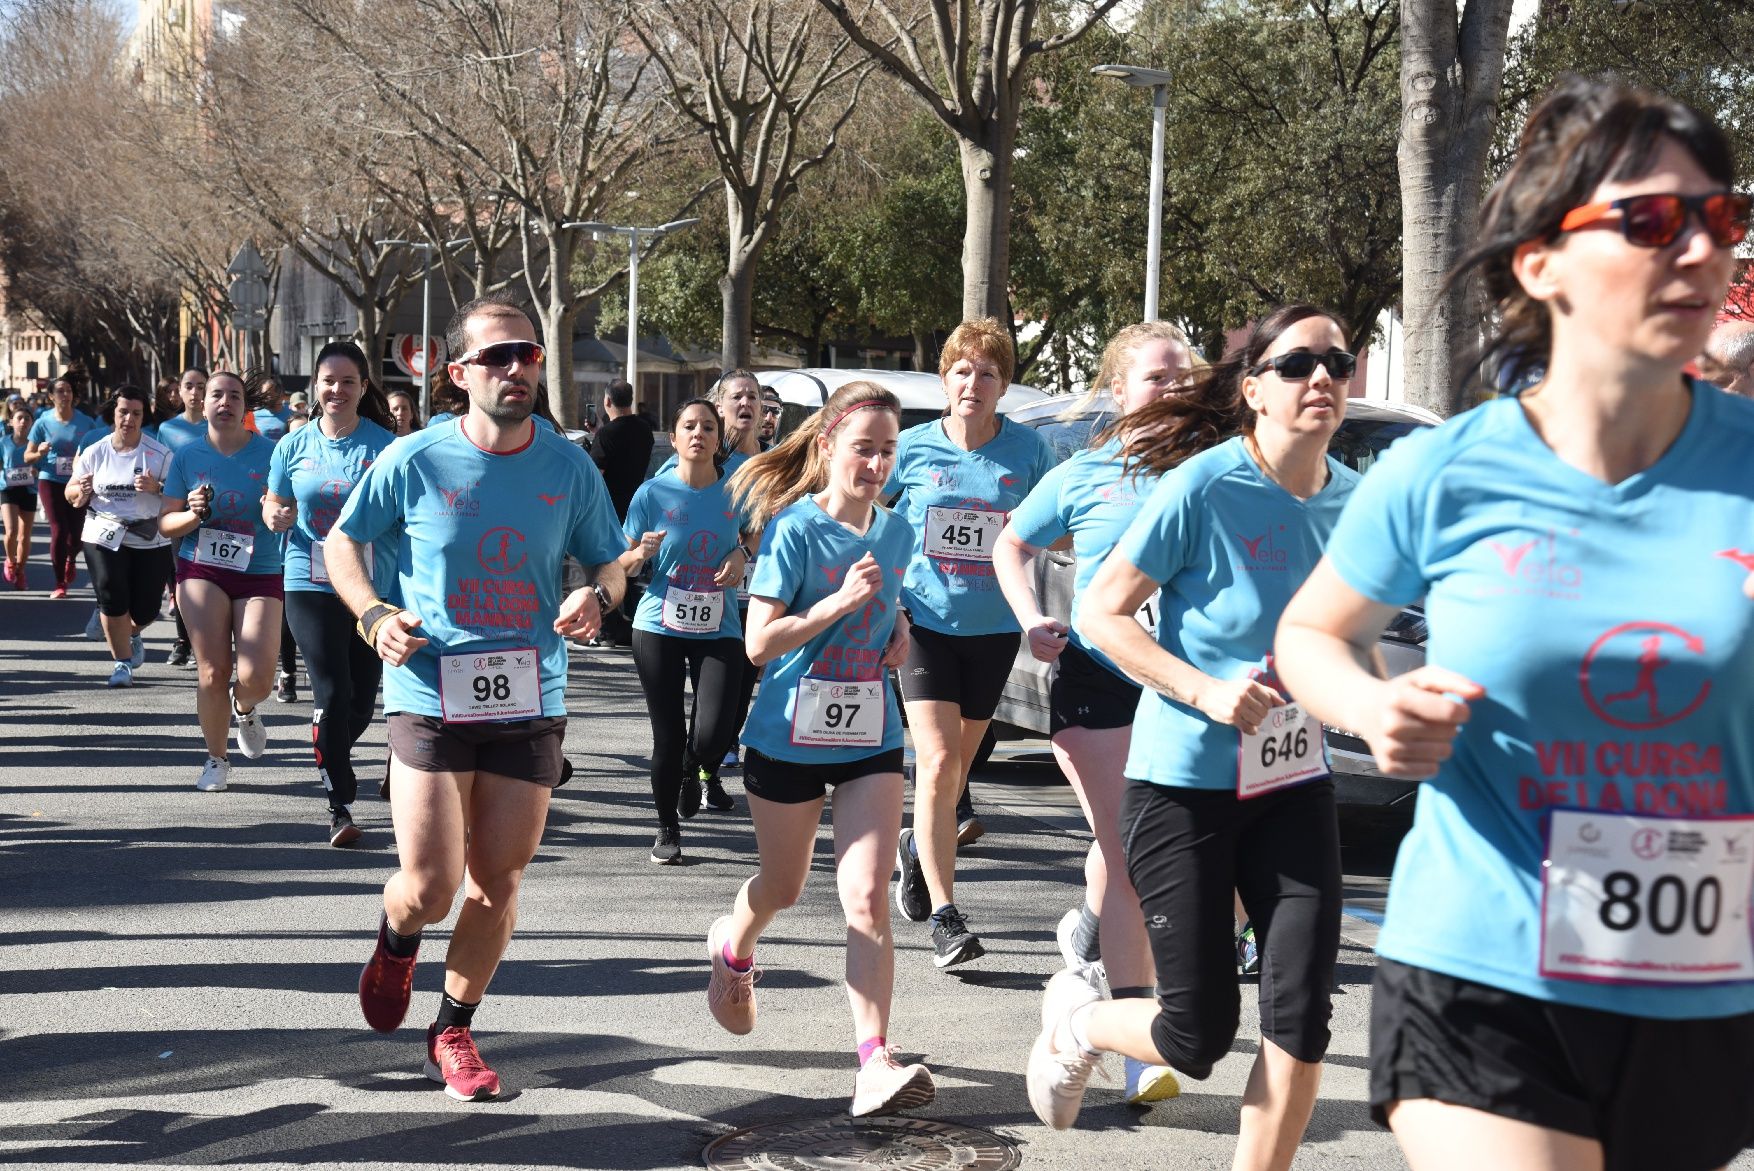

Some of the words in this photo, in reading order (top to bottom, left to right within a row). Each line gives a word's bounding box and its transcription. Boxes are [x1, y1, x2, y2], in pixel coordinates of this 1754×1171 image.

[12, 473, 28, 481] 638
[436, 480, 480, 509] Vela
[100, 528, 115, 541] 78
[942, 525, 983, 547] 451
[1236, 524, 1288, 562] Vela
[210, 541, 241, 559] 167
[458, 578, 479, 593] VII
[482, 579, 536, 595] CURSA
[448, 594, 471, 609] DE
[475, 595, 495, 611] LA
[676, 604, 711, 622] 518
[456, 610, 532, 628] MANRESA
[812, 660, 832, 675] DE
[835, 664, 854, 679] LA
[473, 674, 510, 701] 98
[825, 703, 860, 728] 97
[1261, 727, 1308, 767] 646
[1535, 741, 1587, 776] VII
[1595, 741, 1722, 777] CURSA
[1519, 776, 1570, 811] DE
[1599, 871, 1722, 936] 800
